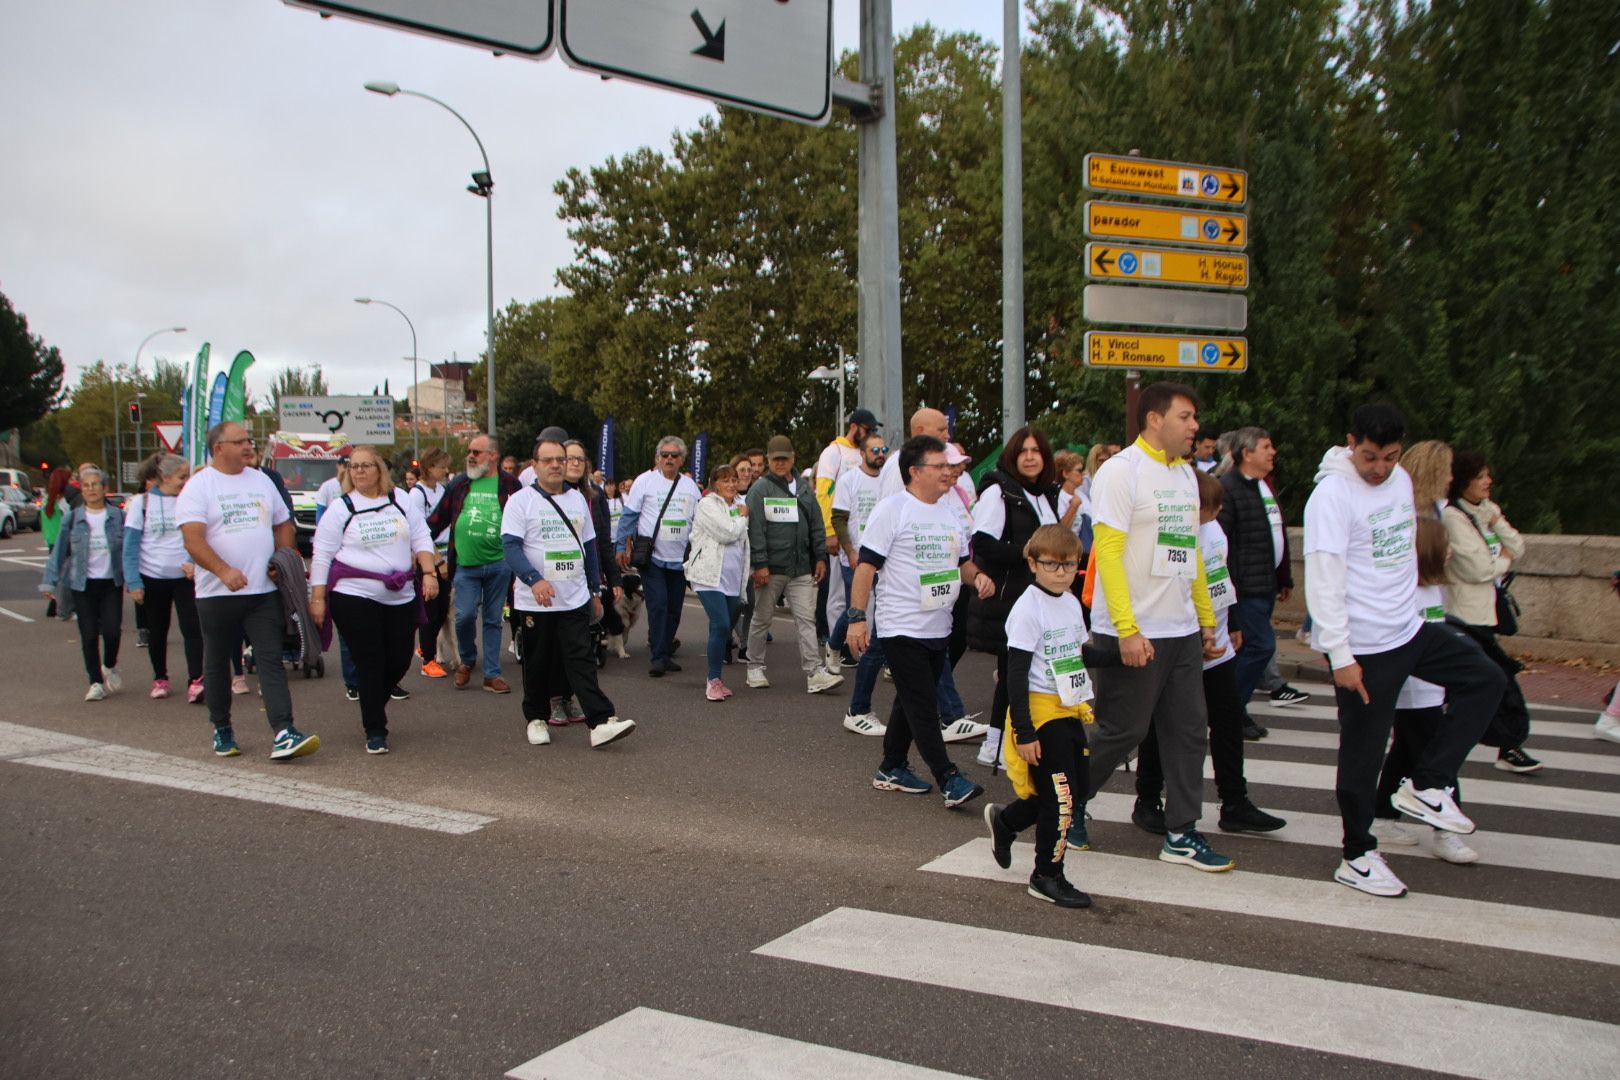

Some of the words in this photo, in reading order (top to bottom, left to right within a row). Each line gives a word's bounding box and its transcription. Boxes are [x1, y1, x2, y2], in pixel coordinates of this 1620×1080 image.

[1092, 161, 1103, 171] H.
[1110, 163, 1164, 178] Eurowest
[1094, 214, 1141, 227] parador
[1199, 258, 1209, 268] H.
[1214, 259, 1243, 270] Horus
[1215, 271, 1244, 283] Regio
[1092, 338, 1103, 349] H.
[1108, 338, 1140, 350] Vincci
[1092, 350, 1102, 360] H.
[1108, 351, 1118, 361] P.
[1122, 352, 1166, 363] Romano
[232, 500, 261, 509] marcha
[1158, 504, 1169, 512] En
[1170, 504, 1196, 512] marcha
[915, 542, 942, 551] contra
[1167, 548, 1187, 563] 7353
[556, 562, 574, 571] 8515
[931, 584, 951, 597] 5752
[1044, 645, 1057, 655] En
